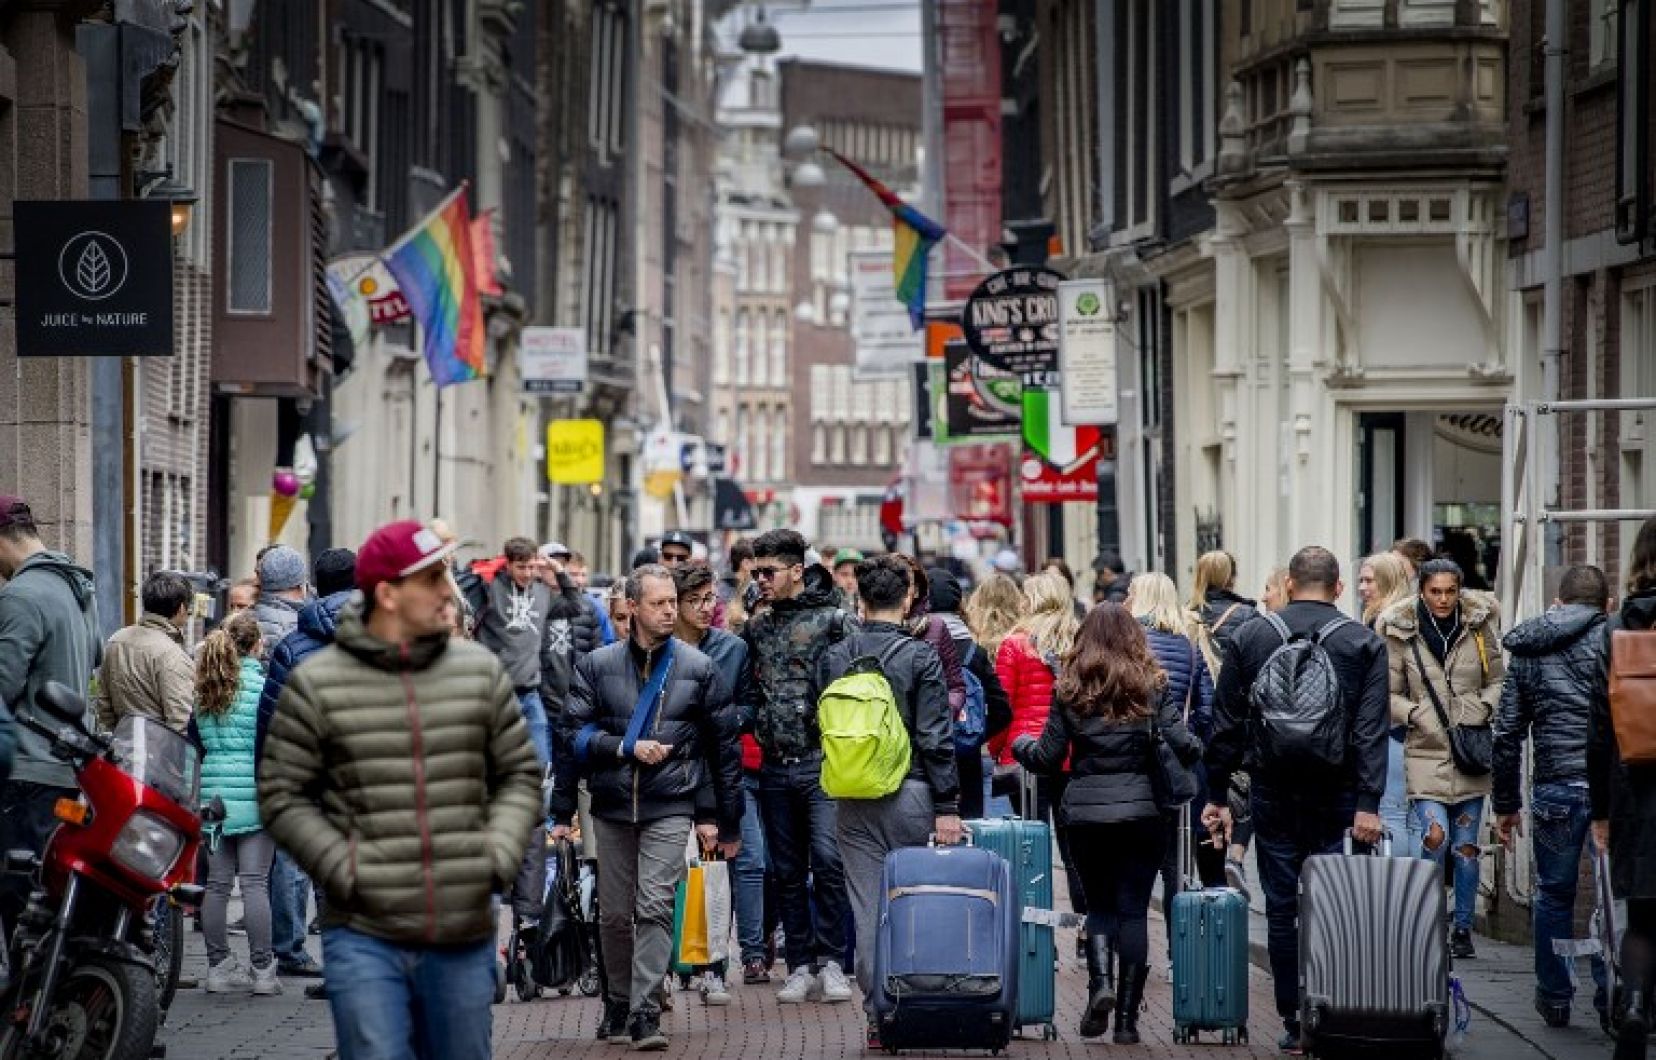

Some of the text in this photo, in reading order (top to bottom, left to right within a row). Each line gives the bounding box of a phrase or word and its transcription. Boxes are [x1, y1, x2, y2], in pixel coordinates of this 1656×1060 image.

[40, 312, 79, 327] JUICE
[96, 312, 148, 325] NATURE
[972, 298, 1022, 326] KING'S
[525, 332, 579, 347] HOTEL
